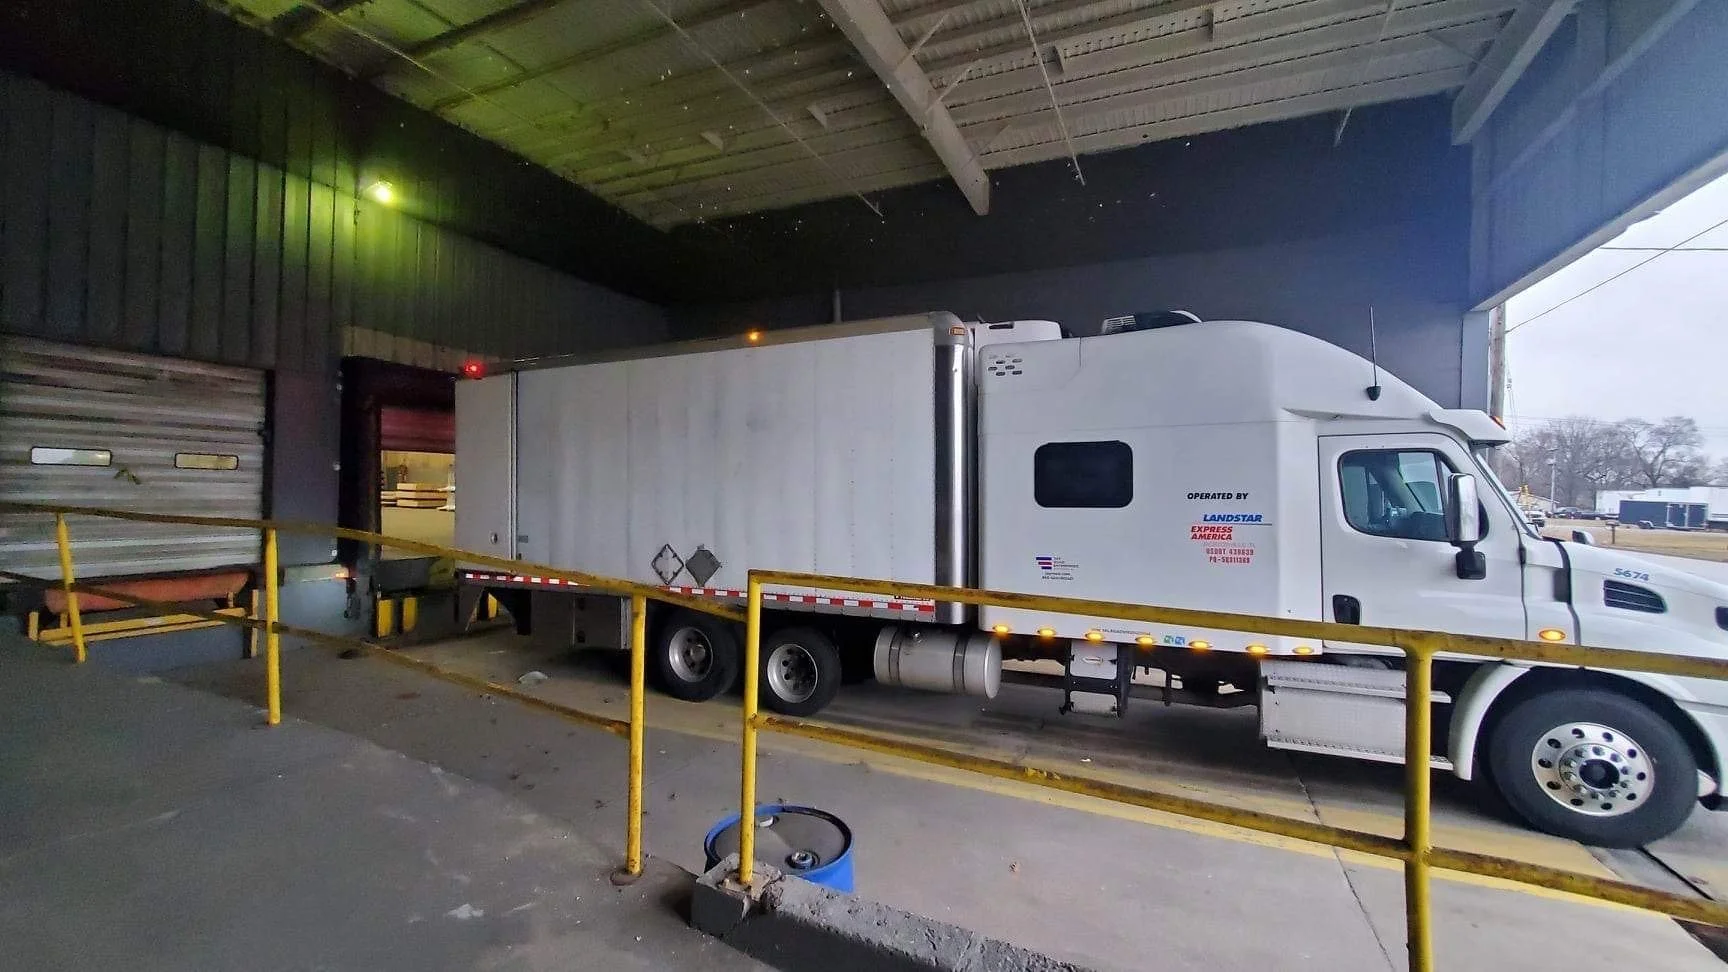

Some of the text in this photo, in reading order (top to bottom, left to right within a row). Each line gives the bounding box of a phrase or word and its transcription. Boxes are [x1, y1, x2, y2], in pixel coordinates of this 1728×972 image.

[1187, 492, 1249, 500] OPERATED BY
[1203, 514, 1263, 522] LANDSTAR
[1190, 525, 1233, 533] EXPRESS
[1191, 533, 1233, 541] AMERICA
[1614, 567, 1650, 581] 5674
